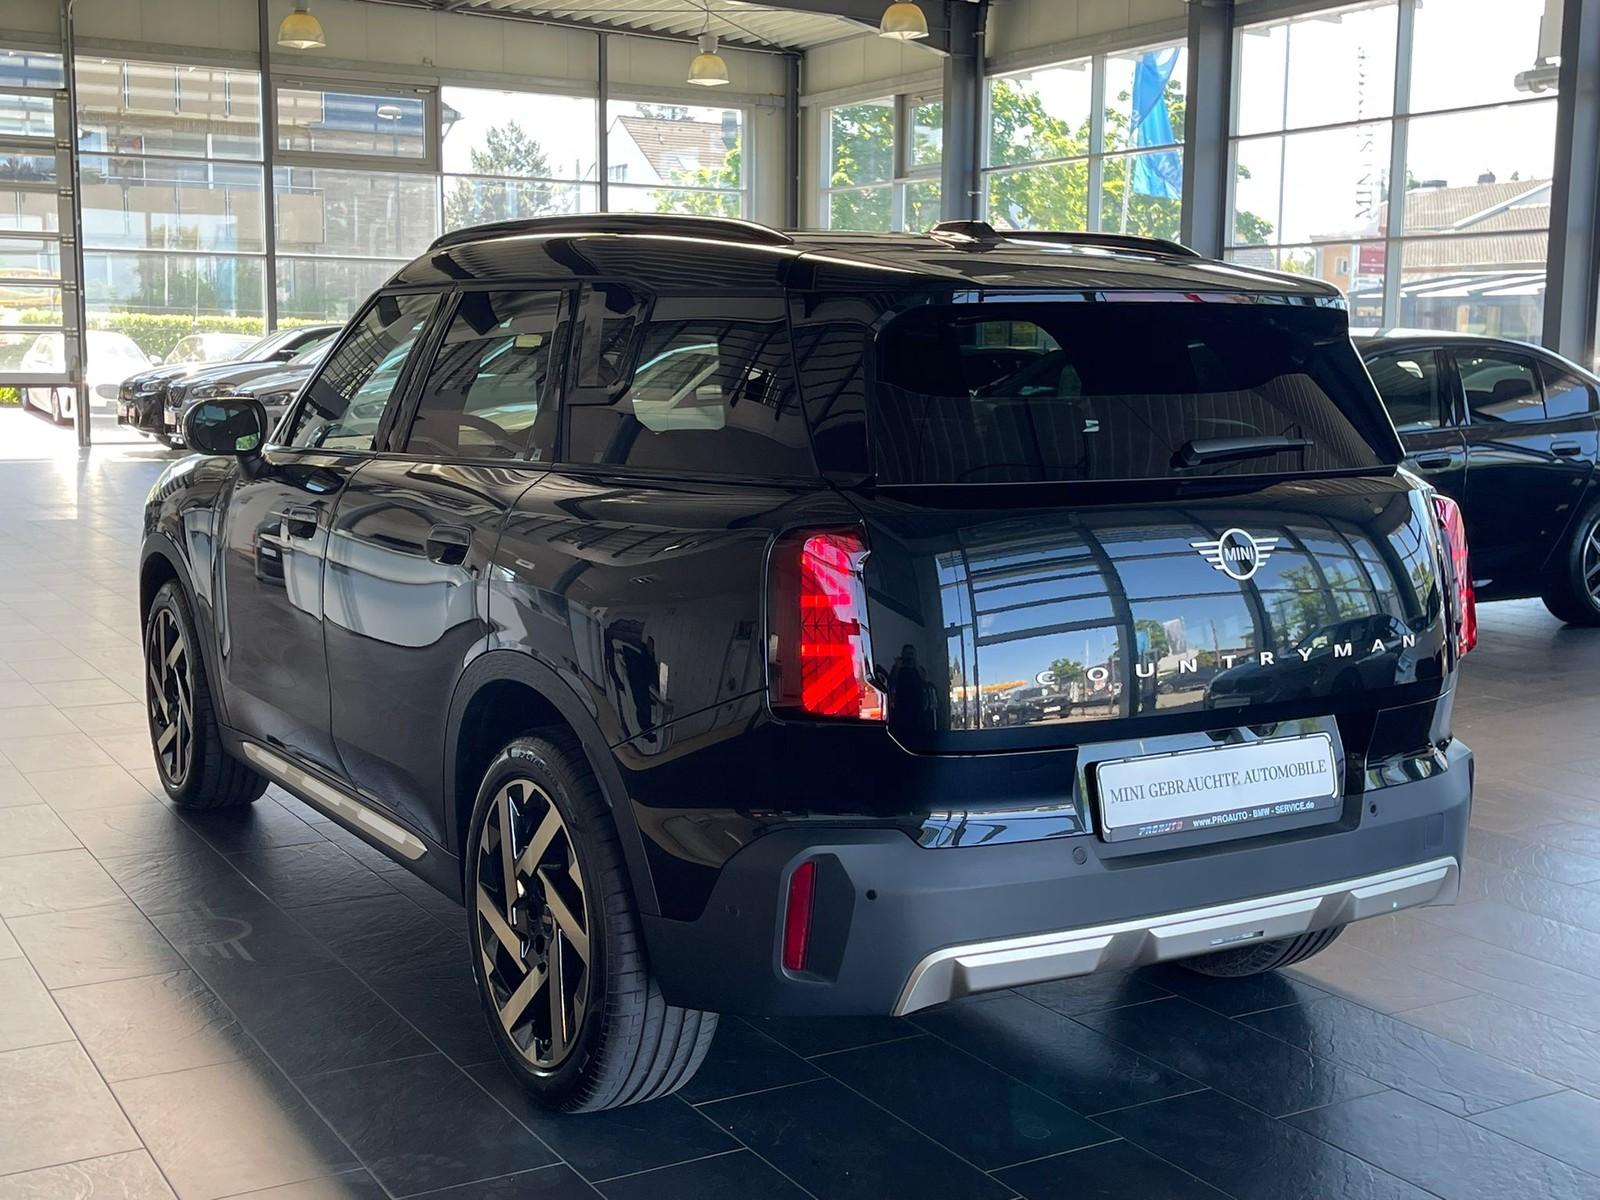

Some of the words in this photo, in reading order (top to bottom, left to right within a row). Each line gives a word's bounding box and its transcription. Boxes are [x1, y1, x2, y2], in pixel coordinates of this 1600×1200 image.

[1224, 546, 1254, 561] MINI
[1036, 634, 1417, 686] COUNTRYMAN
[1110, 784, 1146, 804] MINI
[1149, 771, 1240, 799] GEBRAUCHTE
[1244, 759, 1327, 785] AUTOMOBILE
[1253, 807, 1270, 819] BMW
